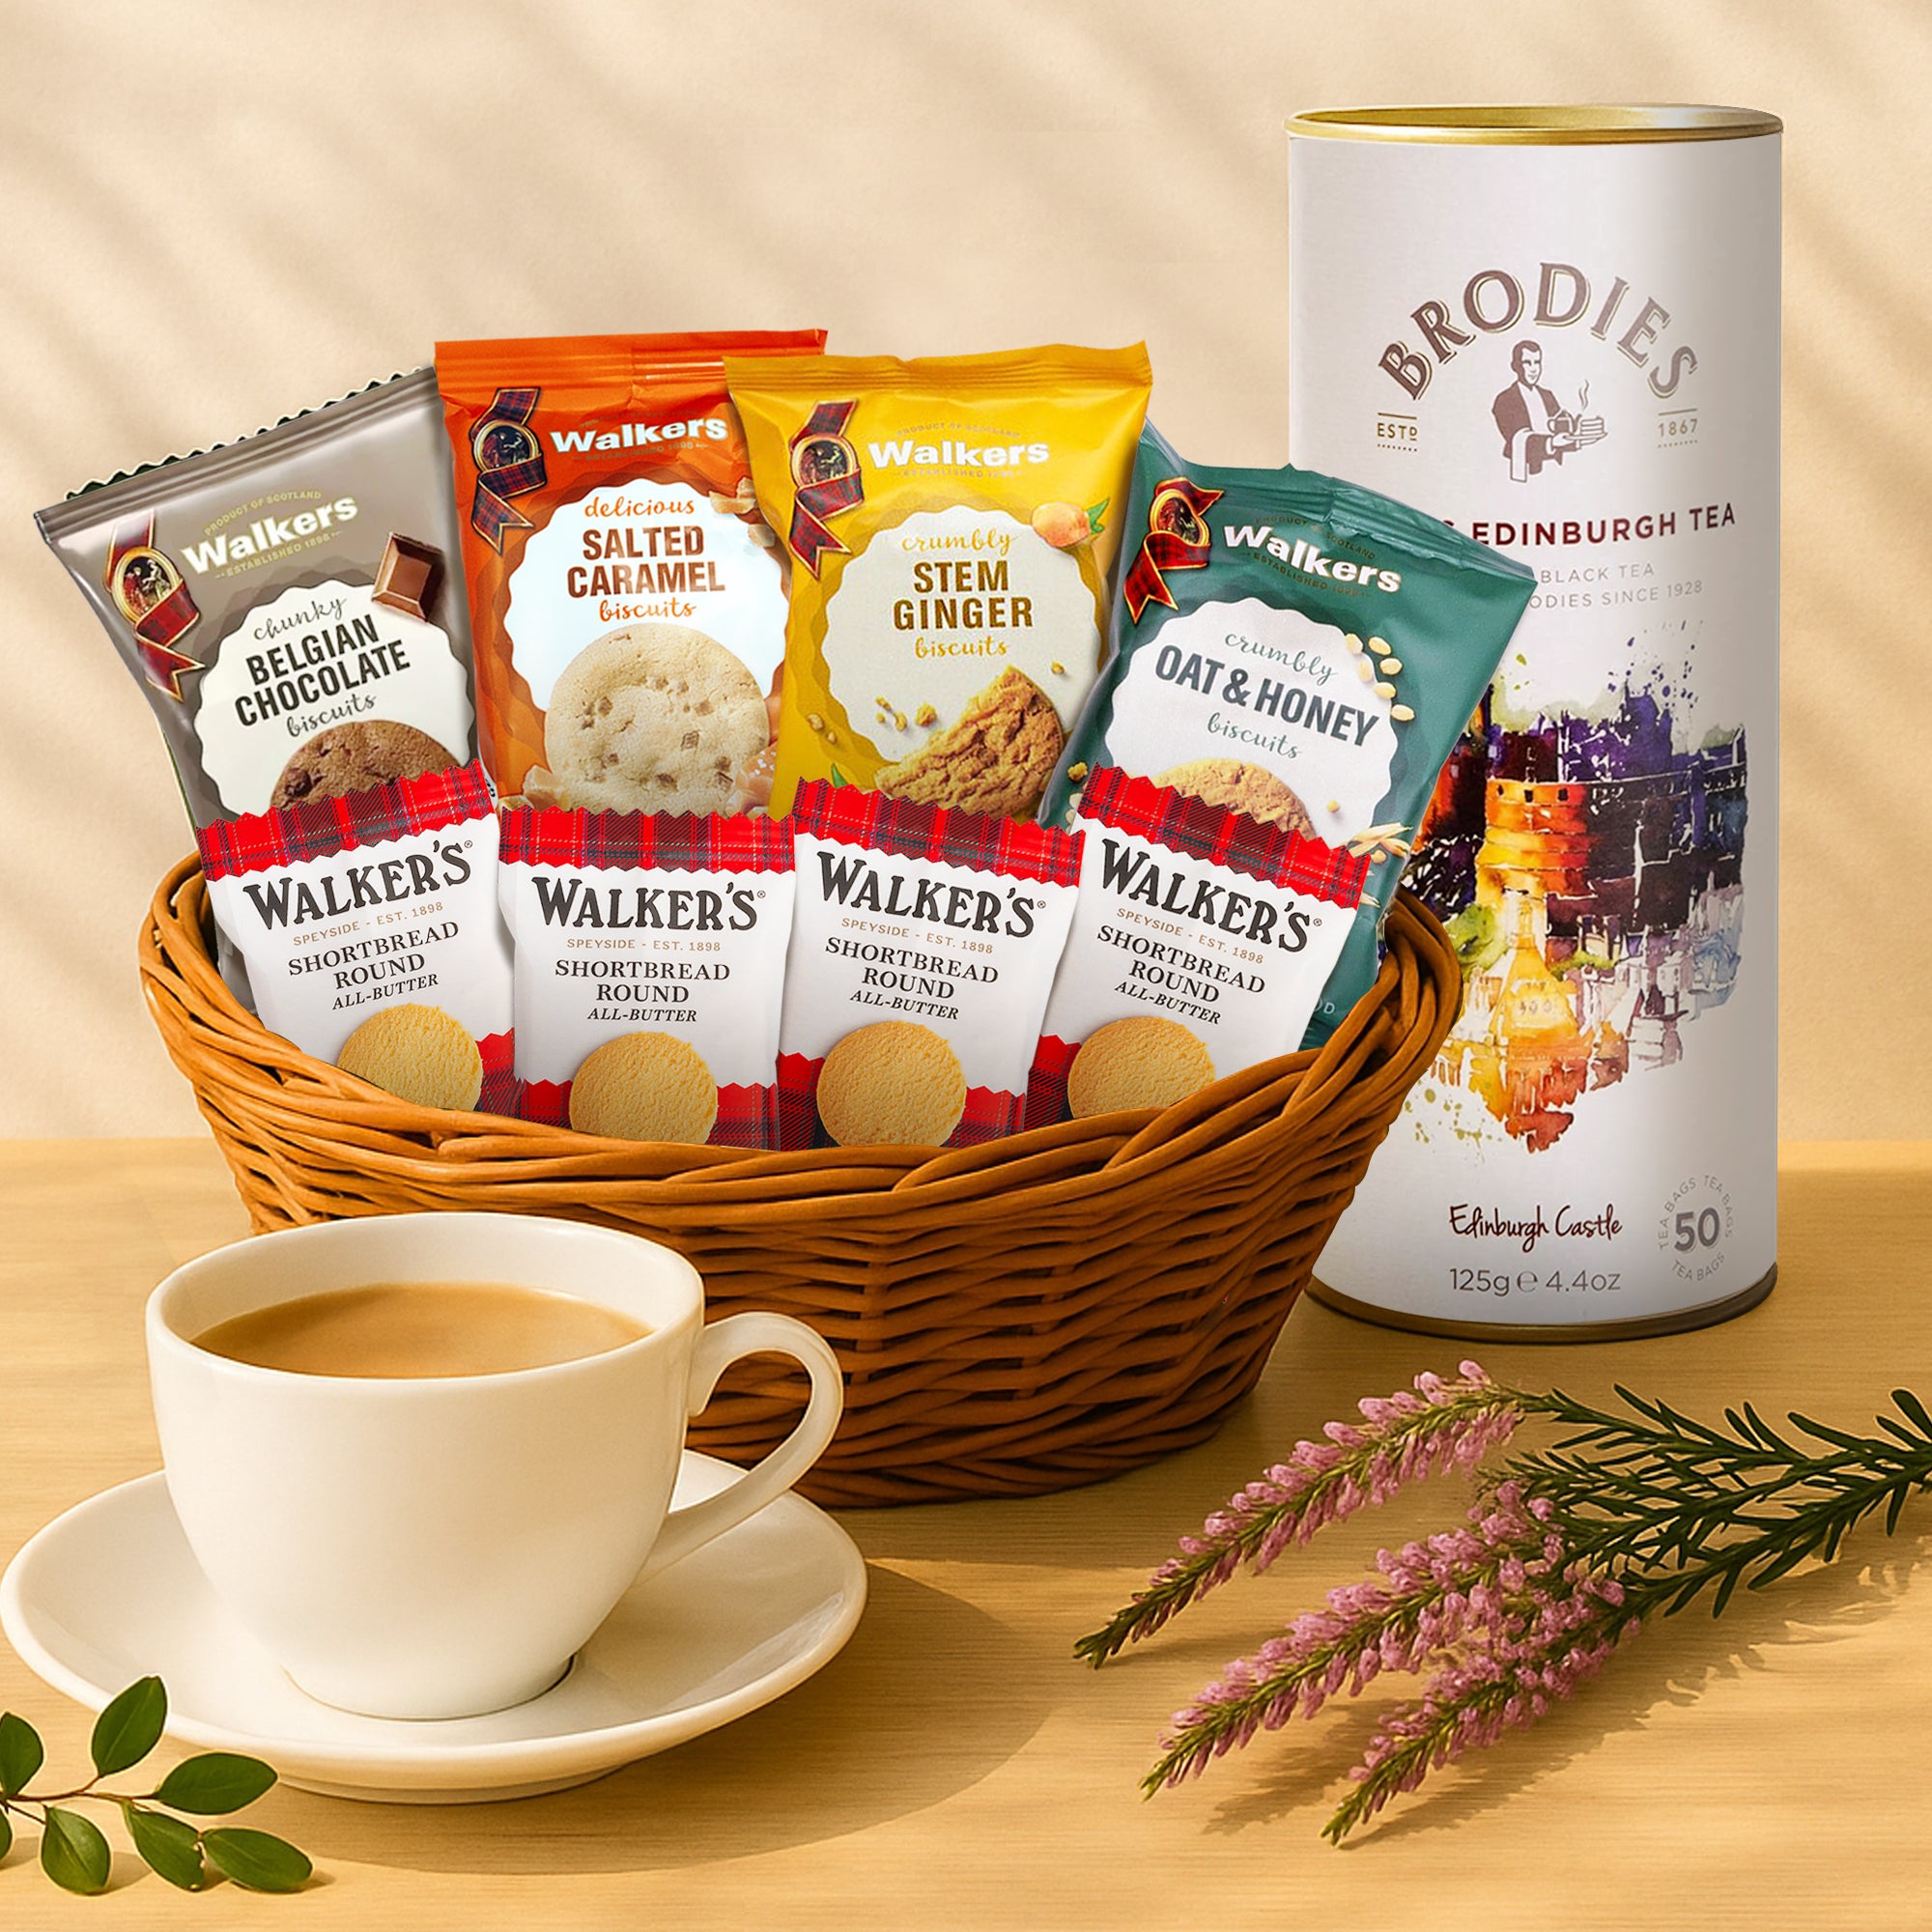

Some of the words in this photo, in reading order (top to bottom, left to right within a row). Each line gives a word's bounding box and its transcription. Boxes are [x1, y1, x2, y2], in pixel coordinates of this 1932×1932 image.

[1378, 262, 1697, 400] BRODIES
[551, 418, 728, 453] Walkers
[1658, 418, 1698, 437] 1867
[867, 440, 1050, 469] Walkers
[204, 504, 249, 536] PRODUCT
[251, 498, 265, 510] OF
[267, 490, 322, 505] SCOTLAND
[584, 496, 695, 518] delicious
[1472, 512, 1676, 546] EDINBURGH
[1689, 502, 1736, 531] TEA
[180, 497, 357, 575] Walkers
[582, 525, 704, 560] SALTED
[902, 528, 1016, 556] crumbly
[226, 543, 302, 577] ESTABLISHED
[305, 535, 330, 550] 1898
[1223, 525, 1402, 593] Walkers
[1253, 552, 1329, 590] ESTABLISHED
[1541, 567, 1608, 584] BLACK
[1619, 562, 1655, 580] TEA
[567, 561, 725, 598] CARAMEL
[913, 559, 1009, 593] STEM
[1529, 593, 1592, 610] ODIES
[1602, 586, 1659, 606] SINCE
[1666, 580, 1703, 598] 1928
[254, 597, 348, 640] chunky
[599, 596, 696, 622] biscuits
[893, 596, 1034, 631] GINGER
[245, 613, 380, 686] BELGIAN
[915, 636, 1009, 659] biscuits
[1225, 632, 1337, 686] crumbly
[234, 639, 411, 726] CHOCOLATE
[1154, 644, 1226, 695] OAT
[1221, 668, 1250, 706] &
[1254, 677, 1379, 747] HONEY
[286, 693, 377, 737] biscuits
[1208, 712, 1302, 759] biscuits
[293, 921, 360, 947] SPEYSIDE
[377, 911, 408, 926] EST.
[412, 901, 443, 919] 1898
[841, 917, 910, 938] SPEYSIDE
[926, 933, 956, 948] EST.
[962, 940, 994, 954] 1898
[1116, 907, 1183, 937] SPEYSIDE
[1199, 934, 1228, 953] EST.
[1232, 946, 1264, 964] 1898
[288, 921, 459, 976] SHORTBREAD
[567, 938, 636, 950] SPEYSIDE
[653, 940, 684, 951] EST.
[689, 942, 721, 952] 1898
[825, 936, 999, 983] SHORTBREAD
[1096, 924, 1265, 993] SHORTBREAD
[333, 952, 425, 990] ROUND
[554, 959, 730, 980] SHORTBREAD
[861, 967, 955, 999] ROUND
[1128, 959, 1220, 1003] ROUND
[331, 973, 439, 1010] ALL-BUTTER
[595, 983, 690, 1003] ROUND
[849, 989, 959, 1020] ALL-BUTTER
[1114, 980, 1221, 1025] ALL-BUTTER
[586, 1008, 697, 1023] ALL-BUTTER
[1703, 1175, 1723, 1193] TEA
[1449, 1203, 1549, 1253] Edinburgh
[1554, 1203, 1623, 1241] Castle
[1658, 1216, 1670, 1251] TEA
[1664, 1177, 1696, 1213] BAGS
[1673, 1207, 1720, 1253] 50
[1449, 1268, 1510, 1296] 125g
[1545, 1269, 1621, 1293] 4.4oz
[1671, 1259, 1692, 1280] TEA
[1696, 1252, 1725, 1282] BAGS
